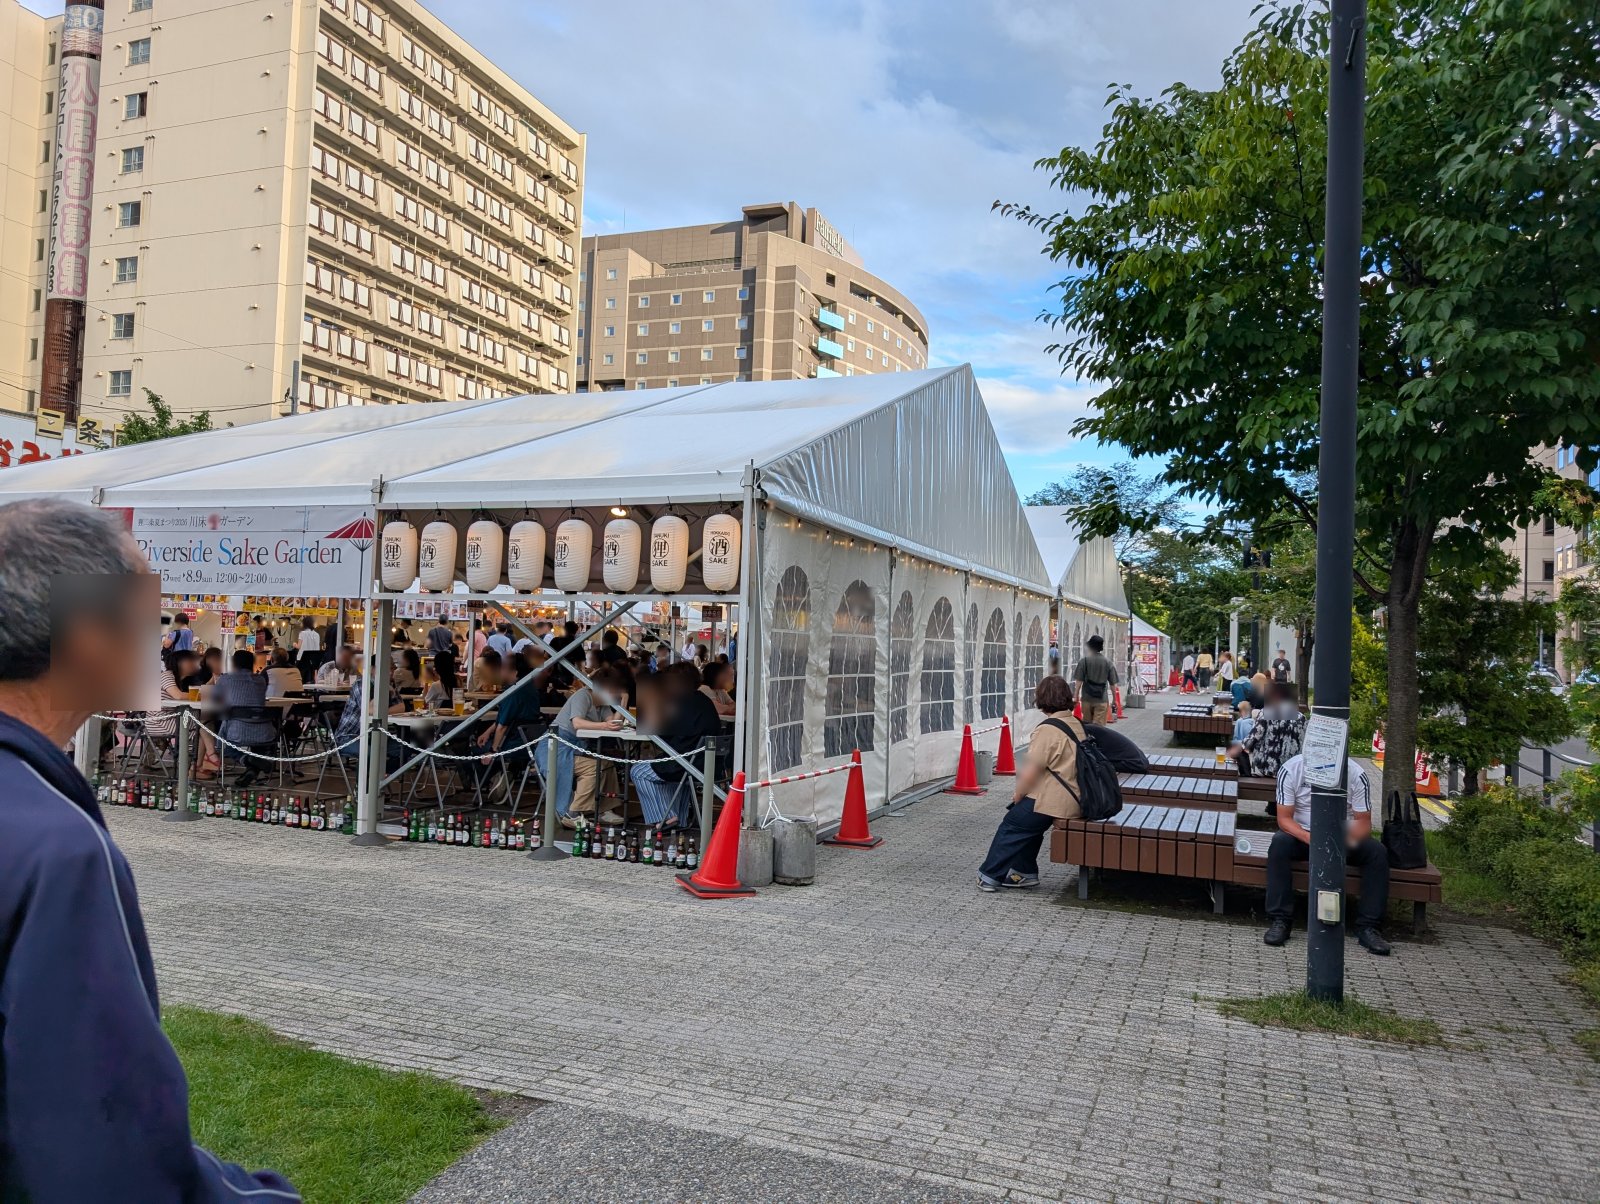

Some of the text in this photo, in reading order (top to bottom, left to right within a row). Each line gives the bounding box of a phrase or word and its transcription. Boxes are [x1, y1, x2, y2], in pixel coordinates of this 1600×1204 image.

[57, 61, 99, 297] 入居者募集
[136, 537, 342, 566] Riverside Sake Garden
[652, 559, 668, 567] SAKE
[709, 557, 728, 565] SAKE
